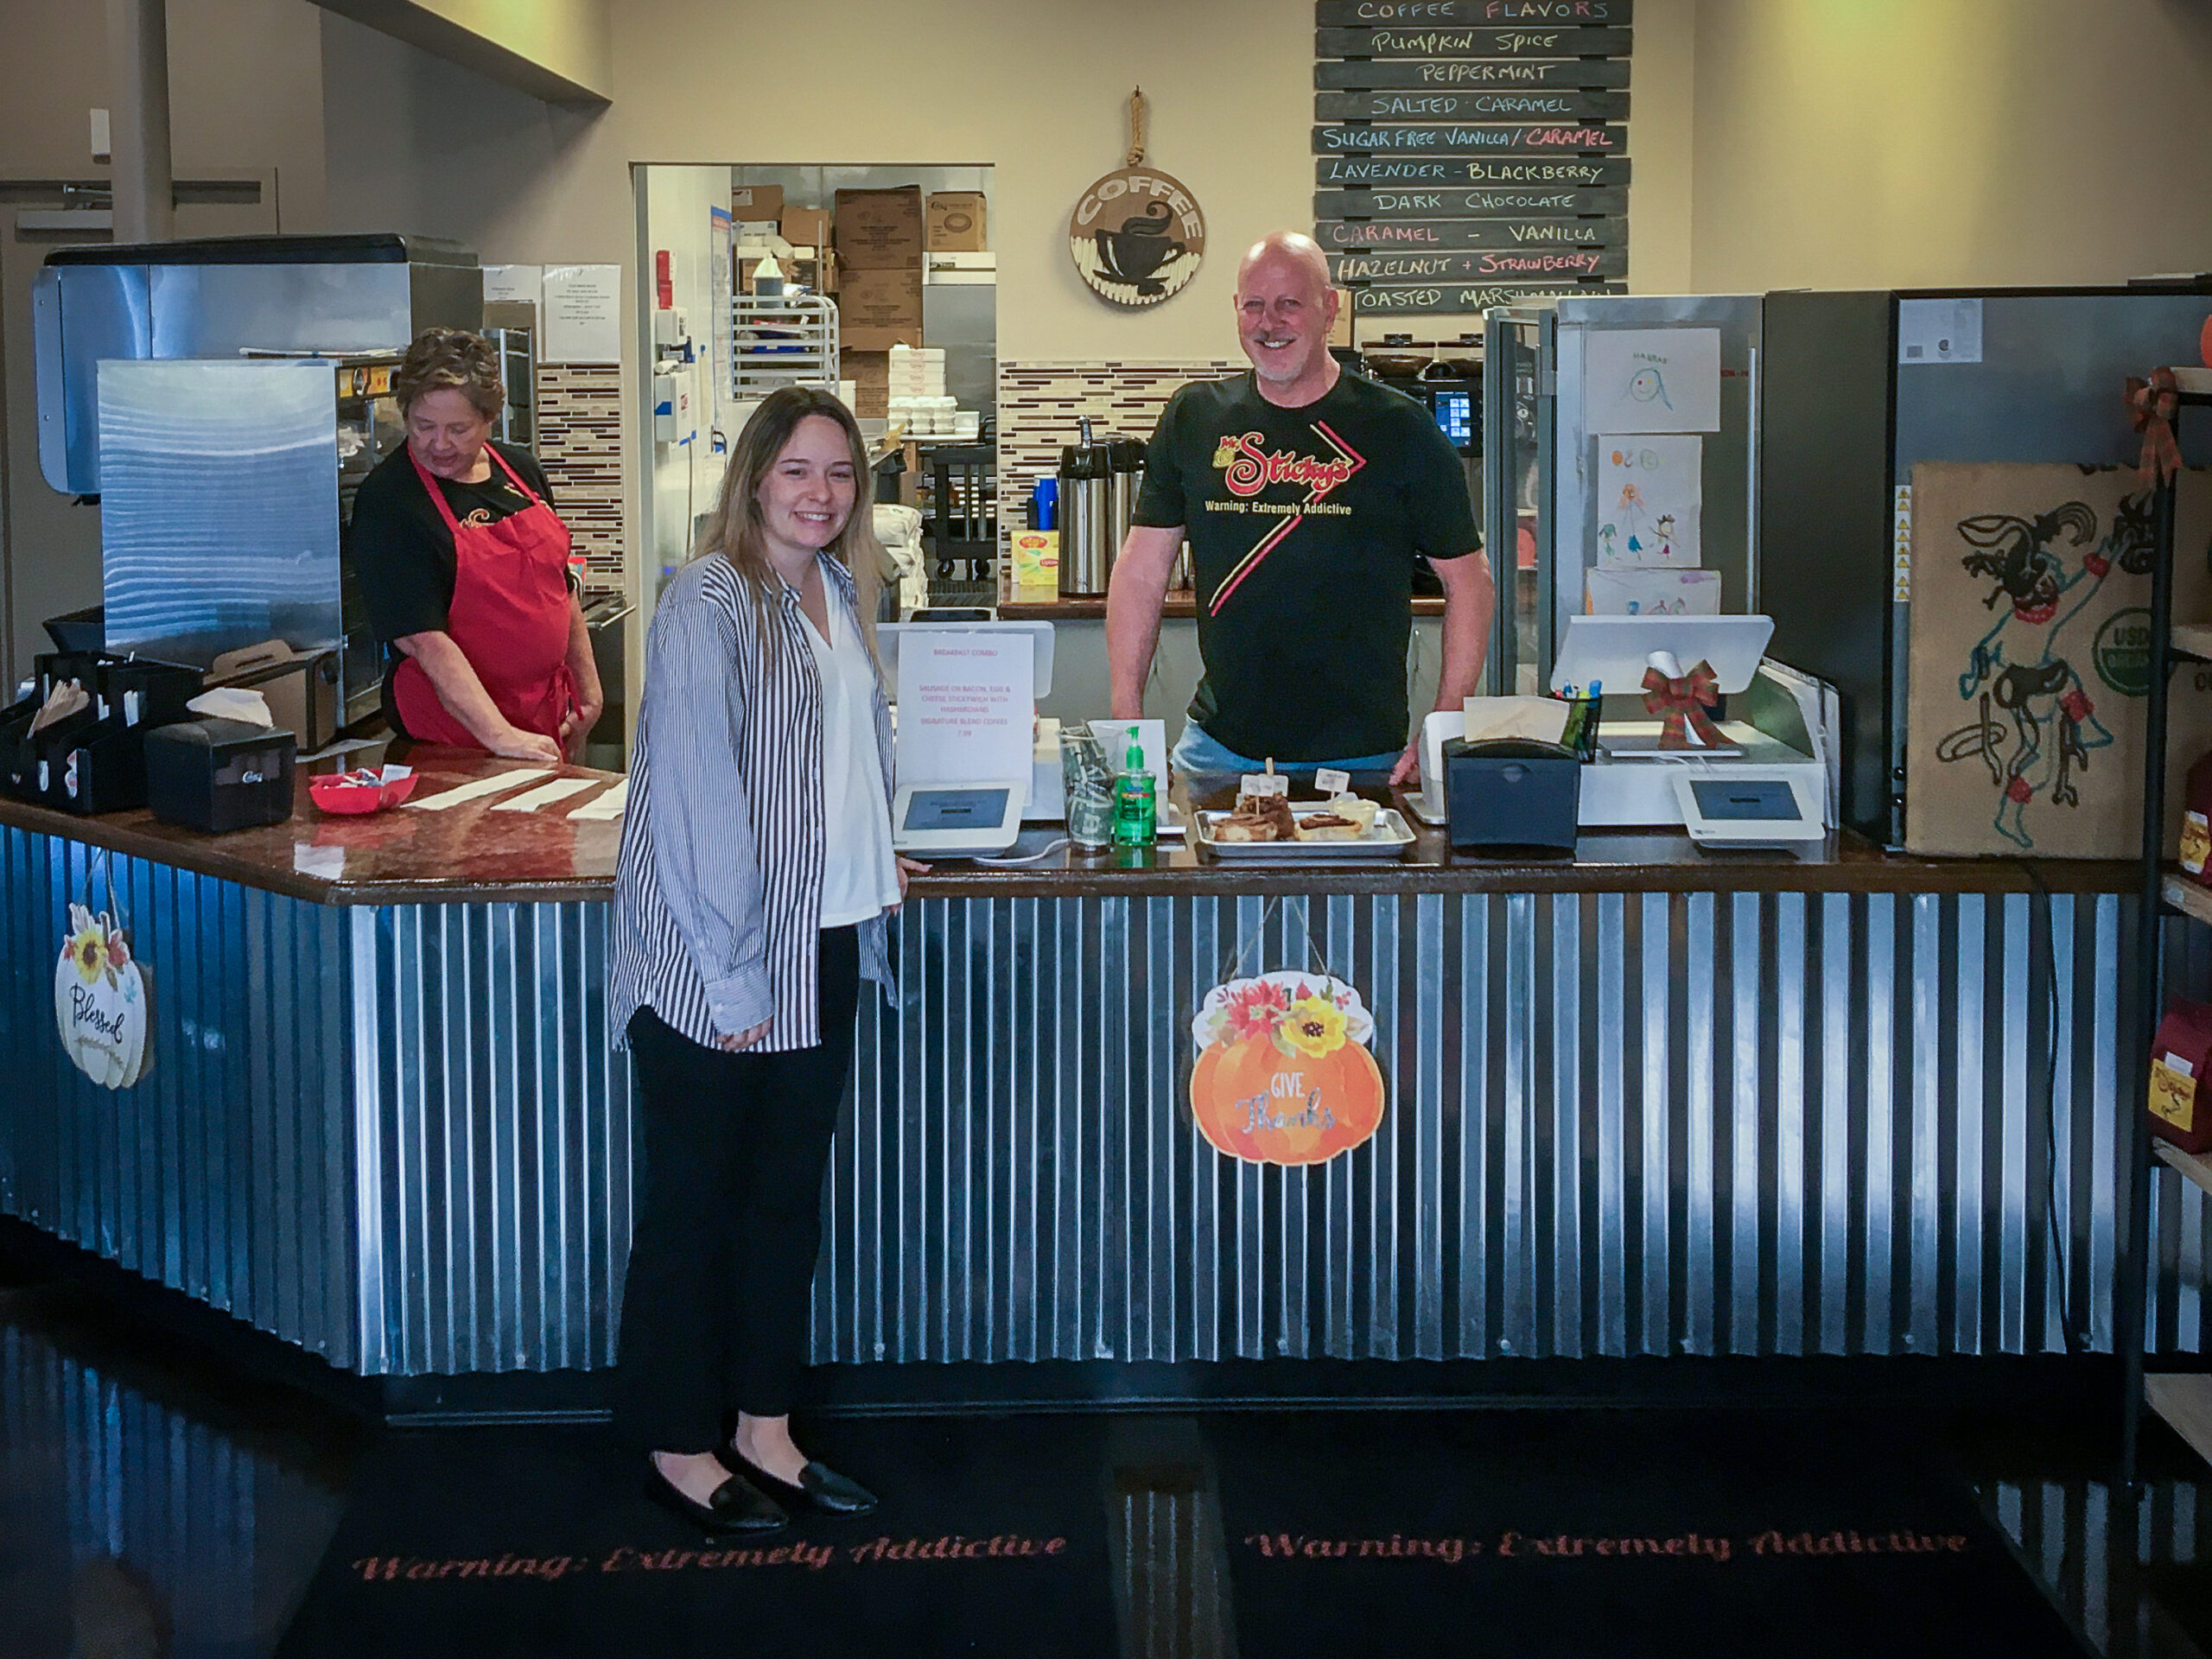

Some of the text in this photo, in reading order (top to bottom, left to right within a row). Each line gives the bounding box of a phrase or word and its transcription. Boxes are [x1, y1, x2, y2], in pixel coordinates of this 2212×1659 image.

[1357, 1, 1608, 19] COFFEE FLAVORS
[1371, 31, 1559, 54] PUMPKIN SPICE
[1415, 64, 1556, 82] PEPPERMINT
[1370, 95, 1573, 114] SALTED CARAMEL
[1323, 128, 1390, 149] SUGAR
[1395, 130, 1437, 148] FREE
[1329, 162, 1446, 180] LAVENDER
[1466, 162, 1605, 184] BLACKBERRY
[1077, 175, 1203, 239] COFFEE
[1373, 192, 1578, 211] DARK CHOCOLATE
[1332, 225, 1440, 245] CARAMEL
[1509, 225, 1596, 242] VANILLA
[1338, 257, 1452, 283] HAZELNUT
[1478, 252, 1600, 274] STRAWBERRY
[1354, 288, 1441, 311] TOASTED
[1205, 500, 1352, 516] Warning: Extremely Addictive
[70, 982, 124, 1045] Blessed
[1270, 1071, 1306, 1098] GIVE
[1235, 1087, 1337, 1135] Thanks
[352, 1534, 1068, 1582] Warning: Extremely Addictive
[1245, 1529, 1967, 1565] Warning: Extremely Addictive
